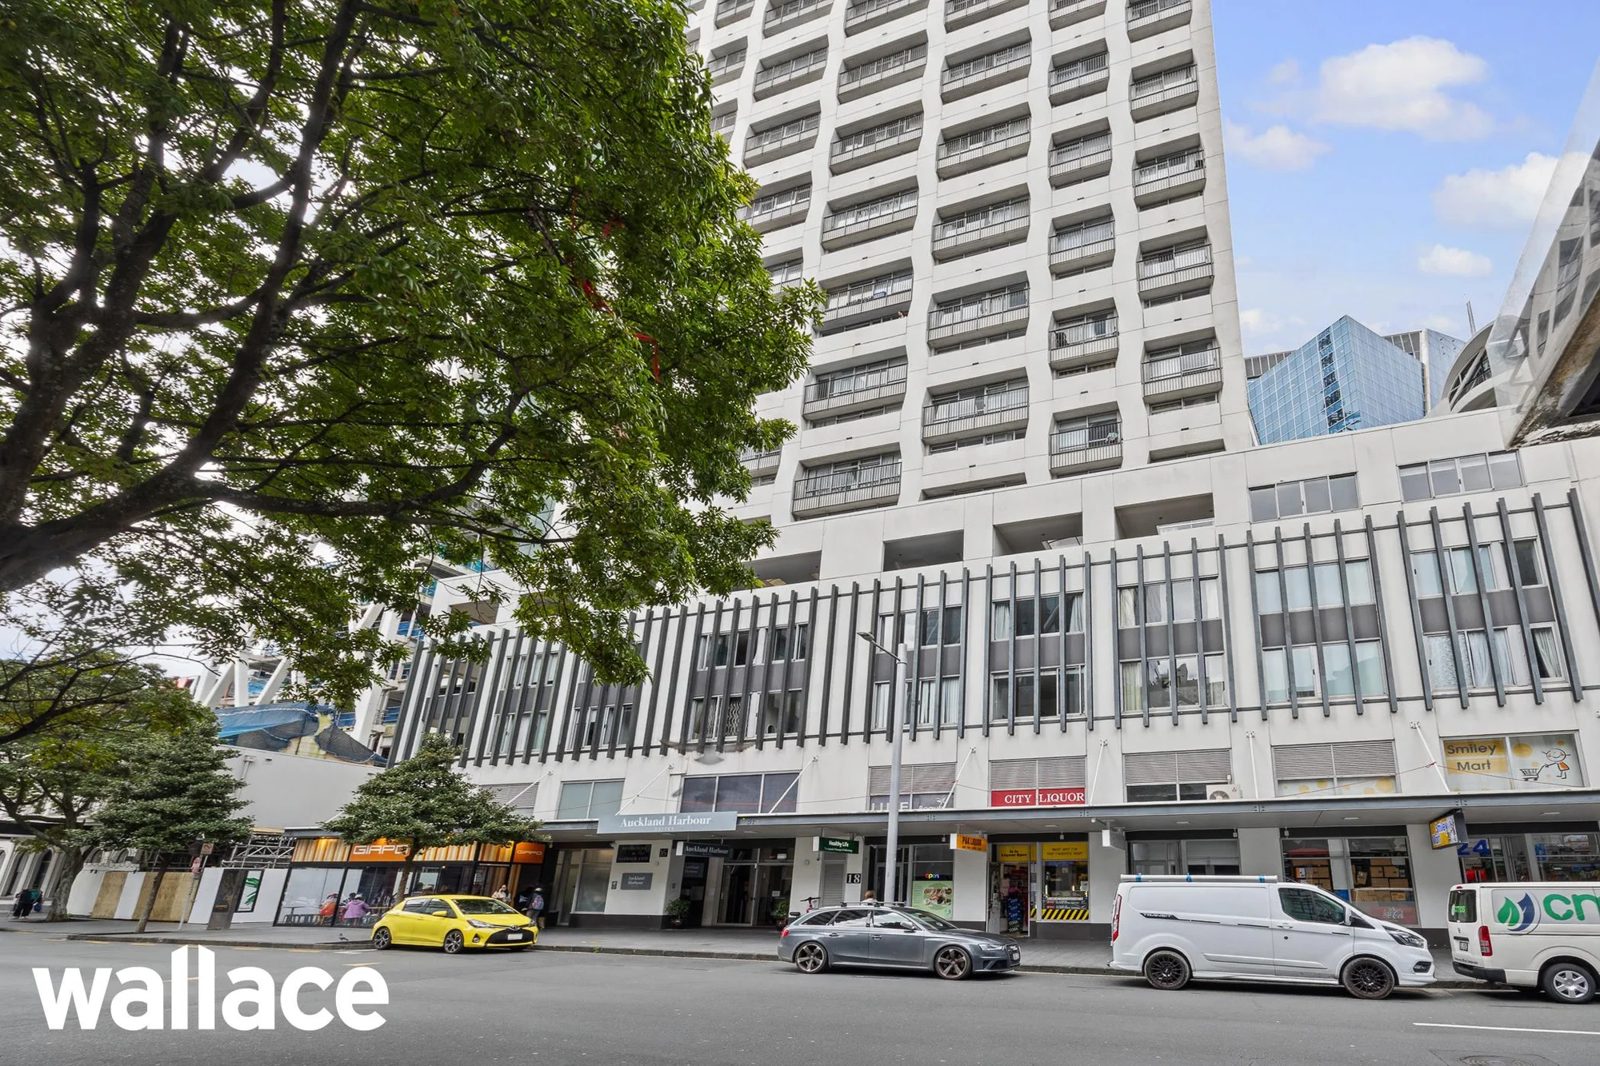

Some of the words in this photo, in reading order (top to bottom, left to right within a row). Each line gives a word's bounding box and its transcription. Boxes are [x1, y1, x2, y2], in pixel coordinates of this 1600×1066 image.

[1447, 744, 1497, 755] Smiley
[1457, 760, 1491, 771] Mart
[1004, 794, 1032, 804] CITY
[1039, 792, 1084, 803] LIQUOR
[621, 818, 665, 828] Auckland
[668, 815, 712, 825] Harbour
[352, 845, 410, 855] GIAPO
[1457, 839, 1490, 857] 24
[848, 874, 860, 883] 18
